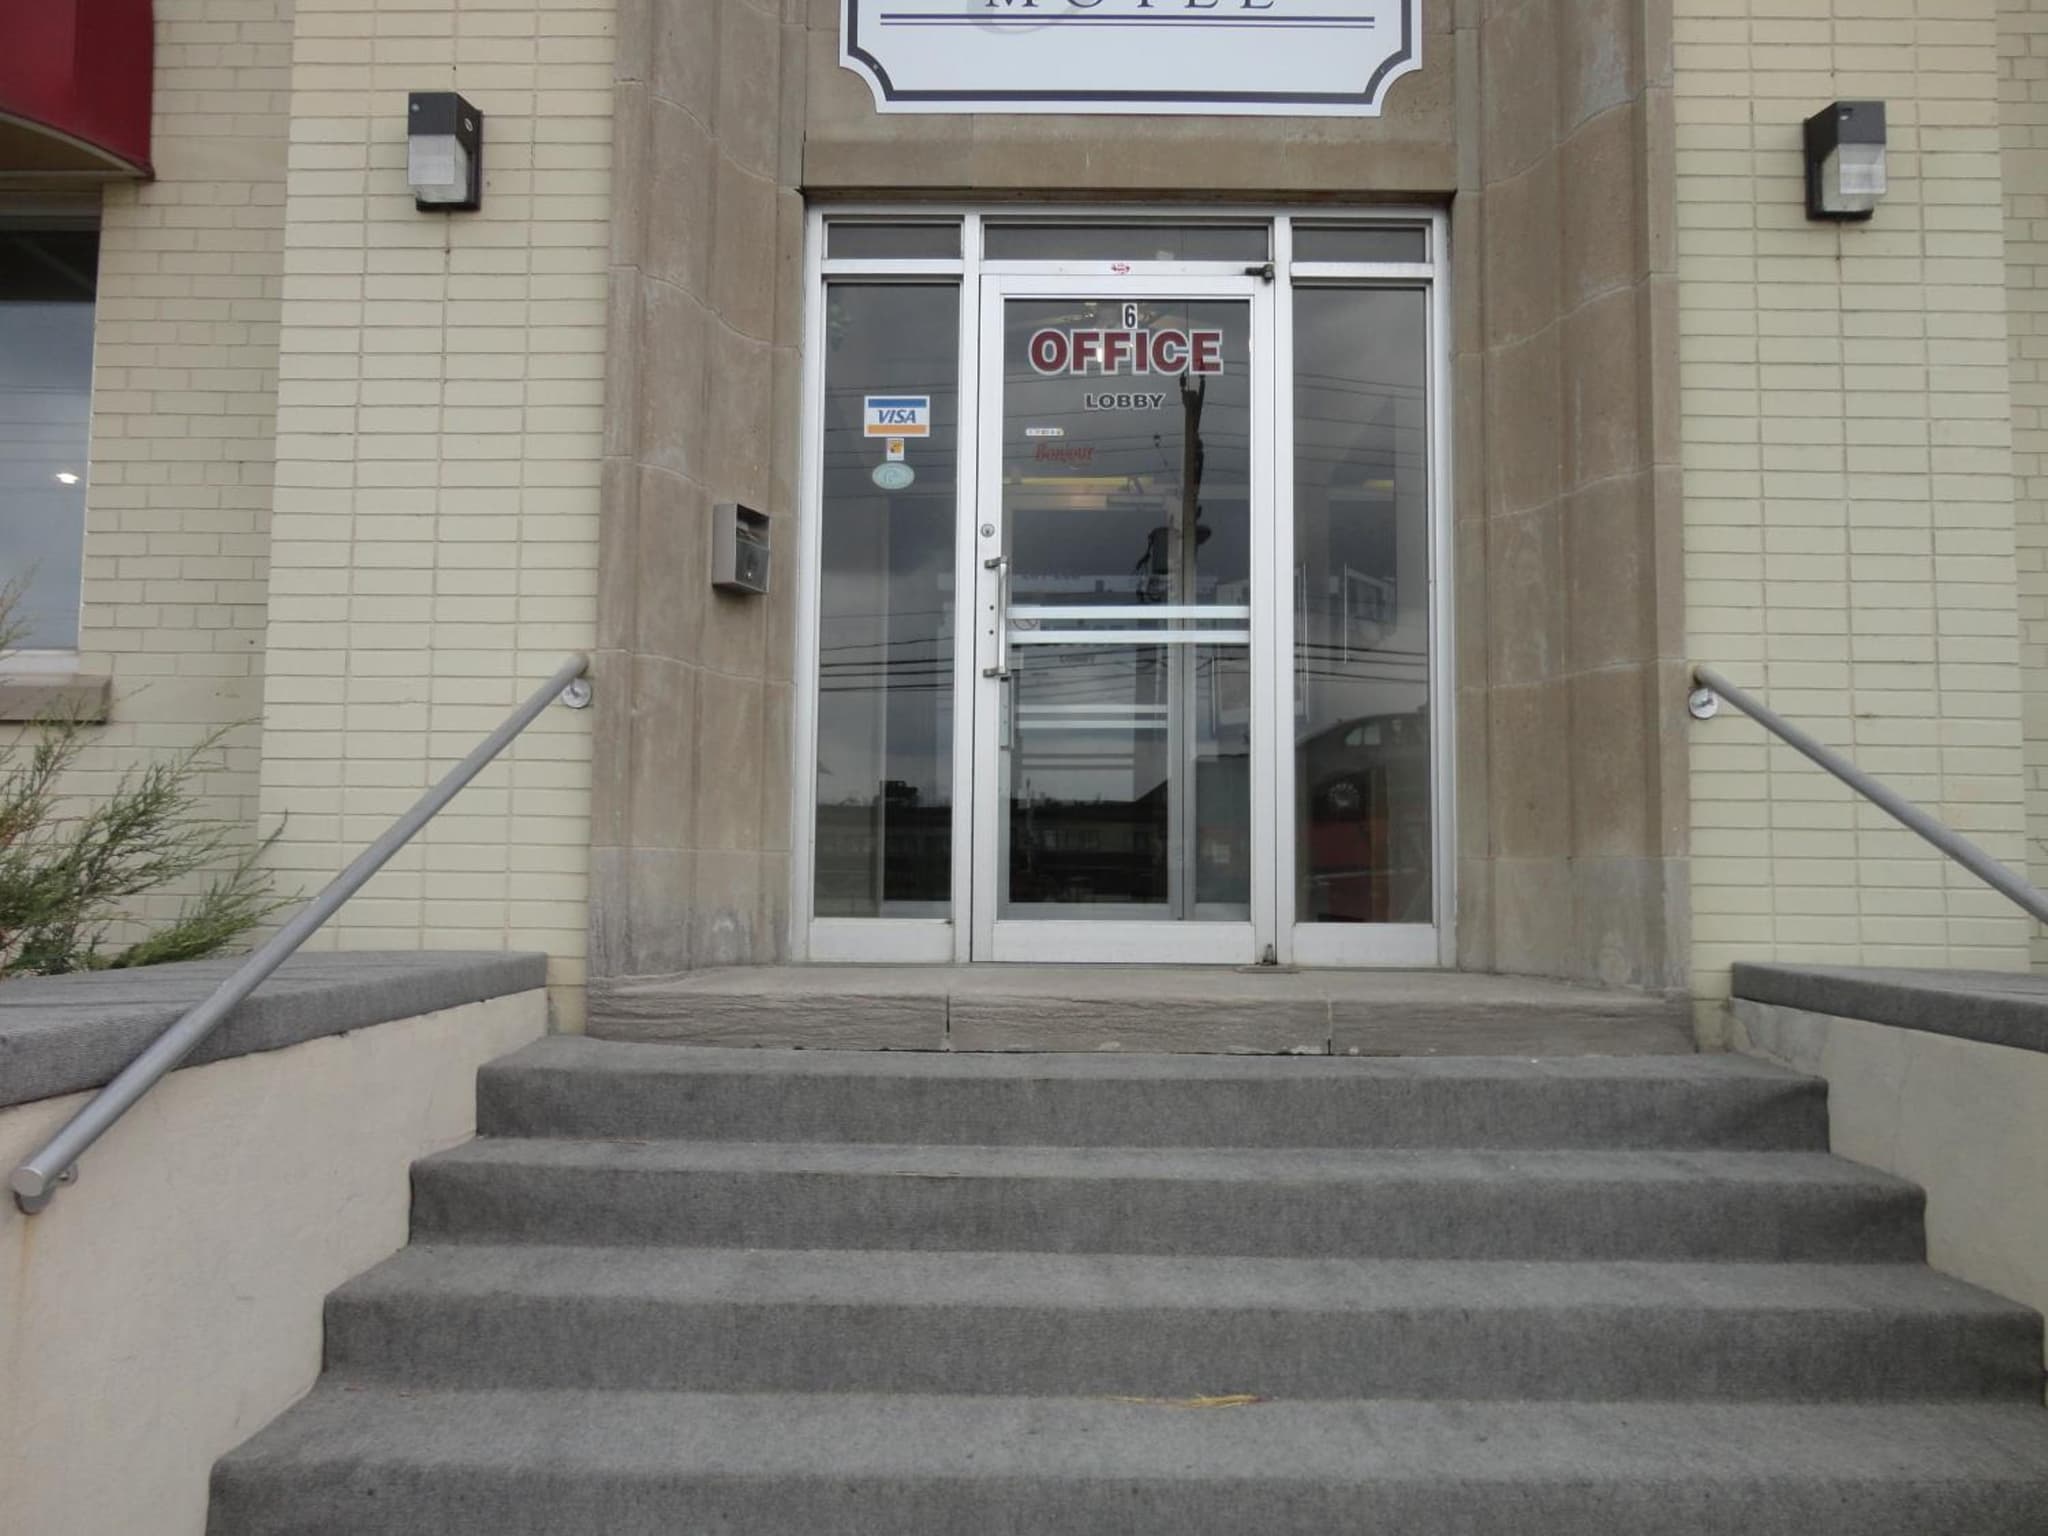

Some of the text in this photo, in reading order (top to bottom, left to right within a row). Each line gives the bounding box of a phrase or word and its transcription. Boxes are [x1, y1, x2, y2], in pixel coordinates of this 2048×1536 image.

[1124, 304, 1137, 328] 6
[1028, 329, 1223, 375] OFFICE
[1084, 393, 1166, 410] LOBBY
[877, 409, 917, 424] VISA
